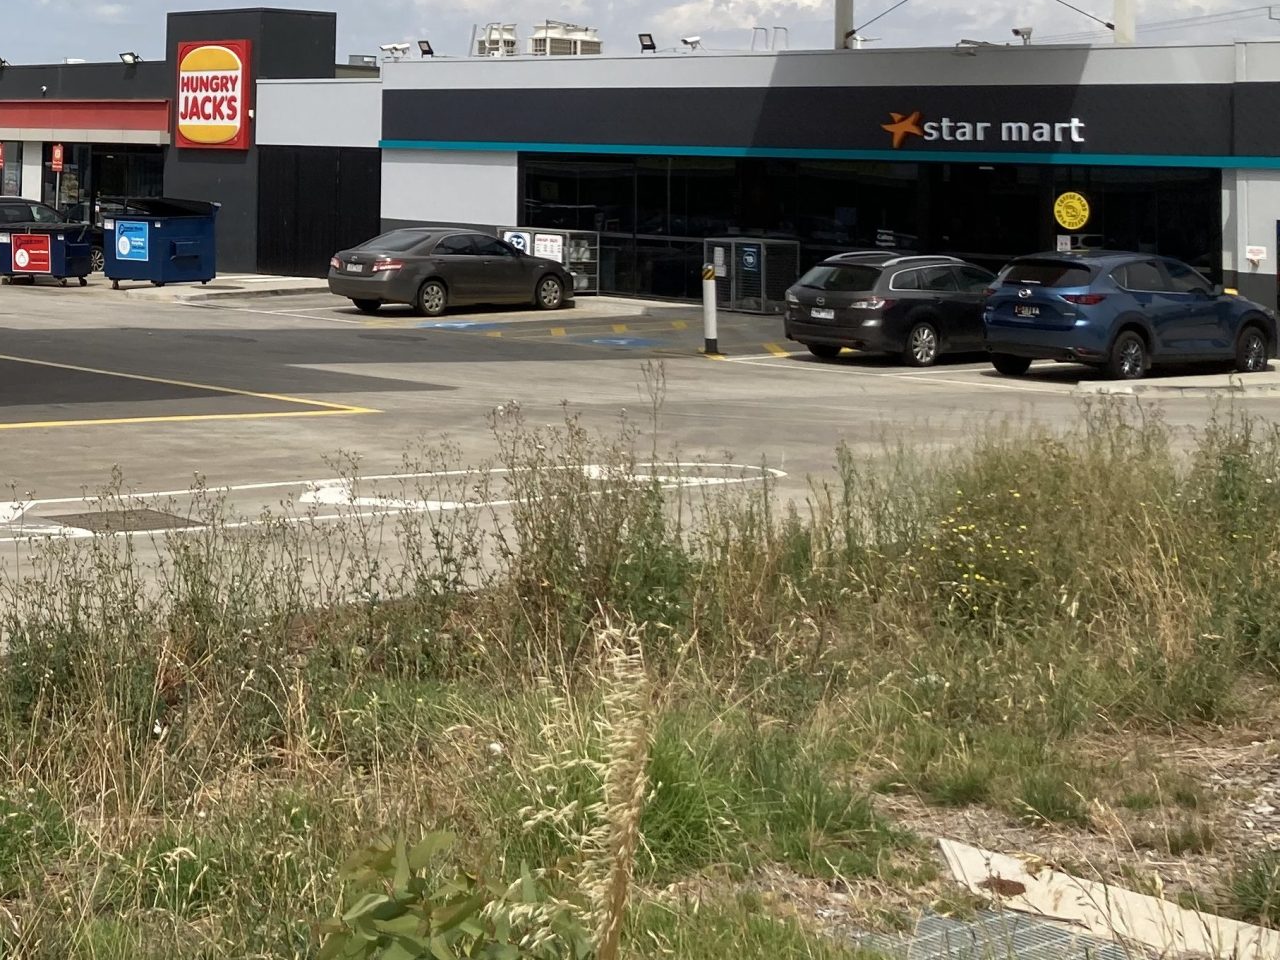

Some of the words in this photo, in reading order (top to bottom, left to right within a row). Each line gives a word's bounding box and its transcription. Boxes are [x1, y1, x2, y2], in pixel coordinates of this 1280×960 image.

[181, 75, 238, 93] HUNGRY
[180, 95, 238, 121] JACK'S
[923, 117, 992, 141] star
[1001, 117, 1085, 143] mart
